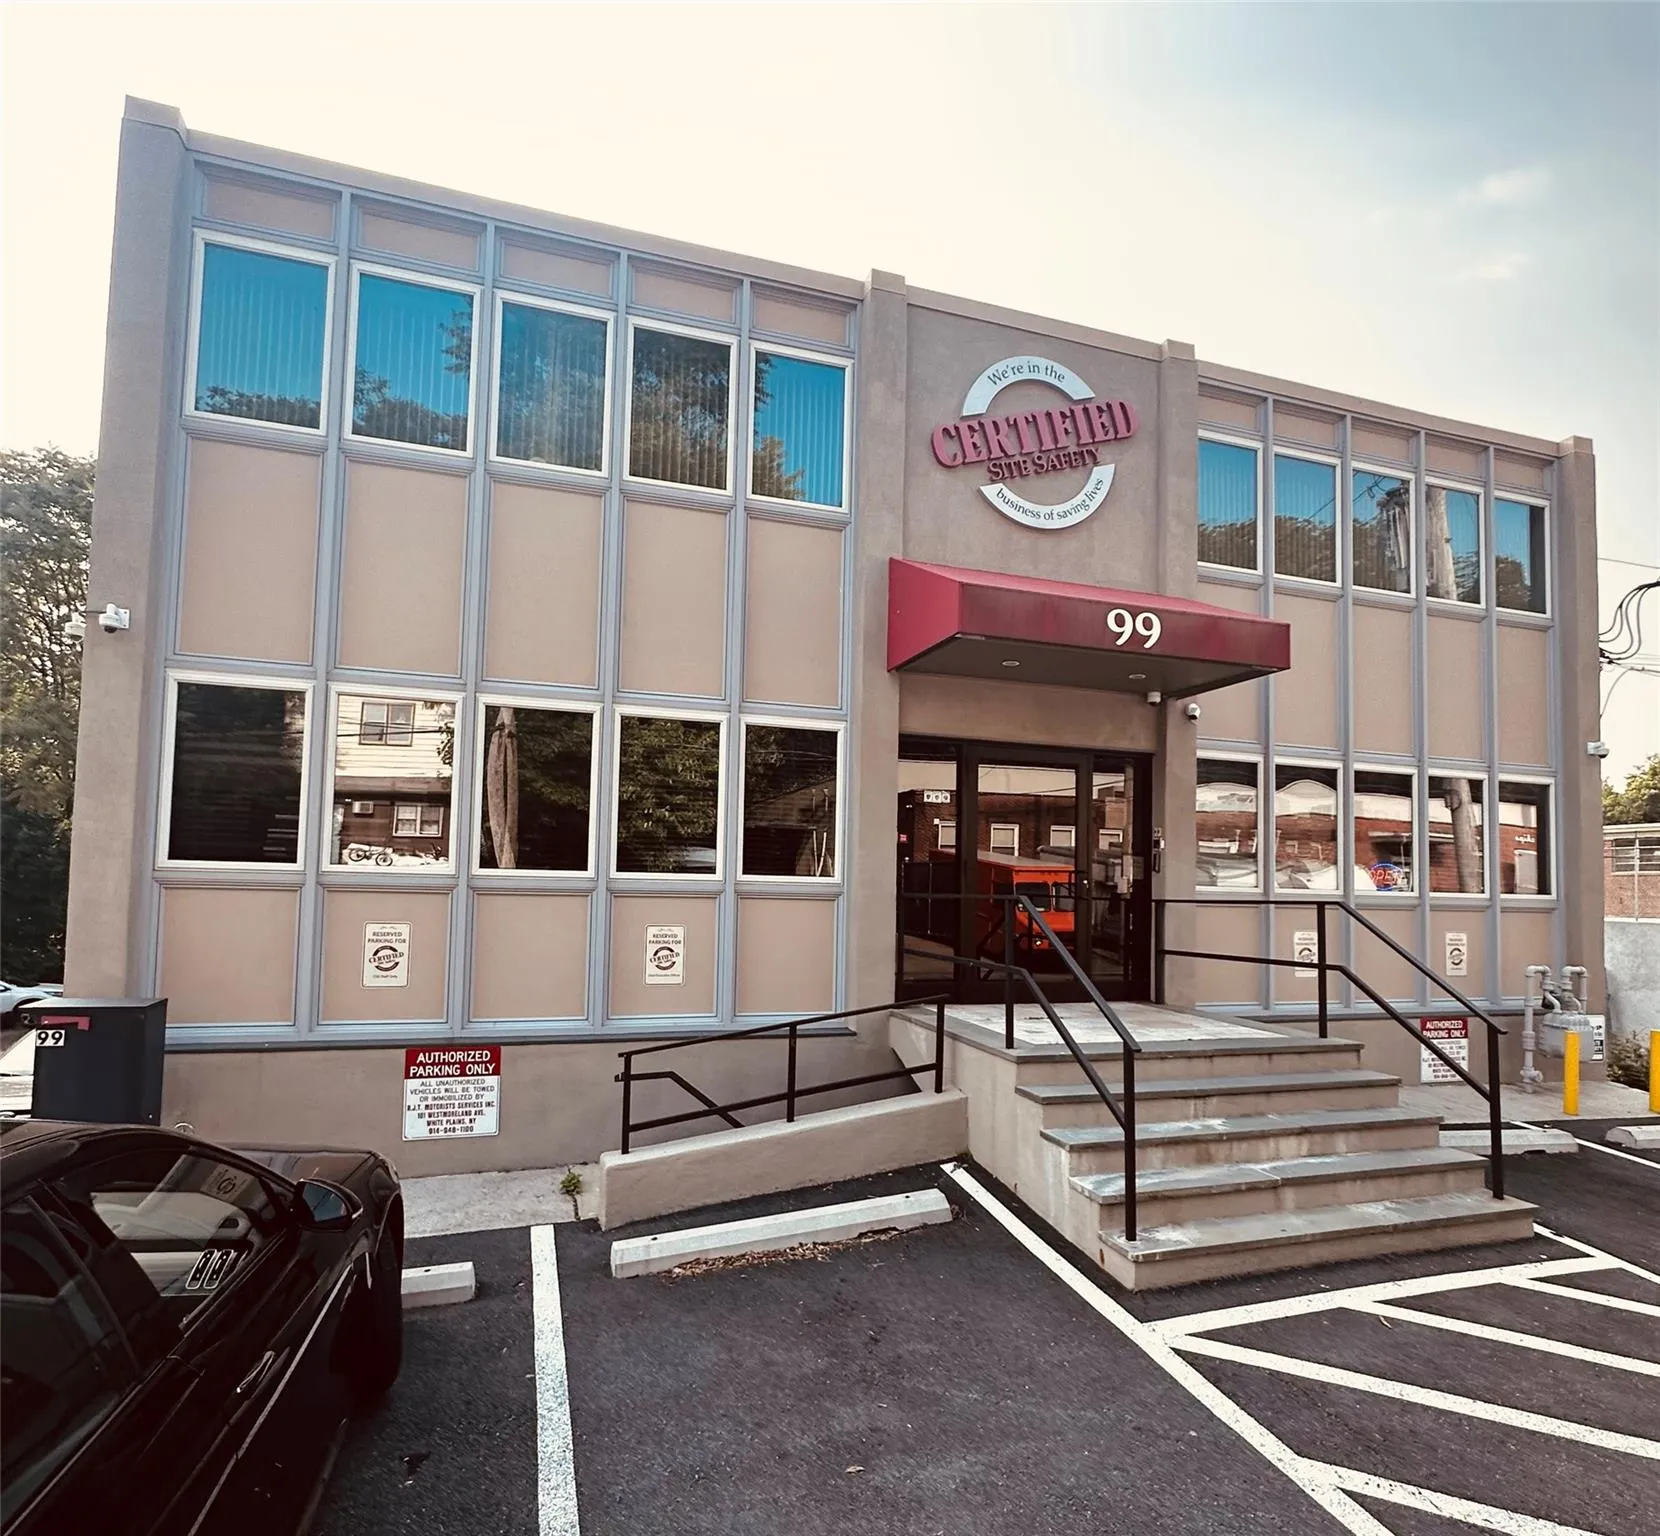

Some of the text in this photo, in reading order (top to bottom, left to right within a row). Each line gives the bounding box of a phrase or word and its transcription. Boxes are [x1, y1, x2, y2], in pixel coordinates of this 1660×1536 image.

[987, 361, 1065, 386] We're in the
[931, 399, 1139, 468] CERTIFIED
[988, 447, 1101, 481] SITE SAFETY
[996, 479, 1104, 520] business of saving lives
[1106, 608, 1162, 649] 99
[1425, 1020, 1463, 1029] AUTHORIZED
[37, 1031, 63, 1045] 99
[1422, 1029, 1466, 1038] PARKING ONLY
[416, 1050, 491, 1064] AUTHORIZED
[409, 1063, 496, 1077] PARKING ONLY
[431, 1094, 473, 1102] IMMOBILIZED
[424, 1102, 456, 1110] MOTORISTS
[457, 1101, 483, 1109] SERVICES
[427, 1110, 472, 1119] WESTMORELAND
[426, 1119, 444, 1127] WHITE
[468, 1117, 477, 1125] NY
